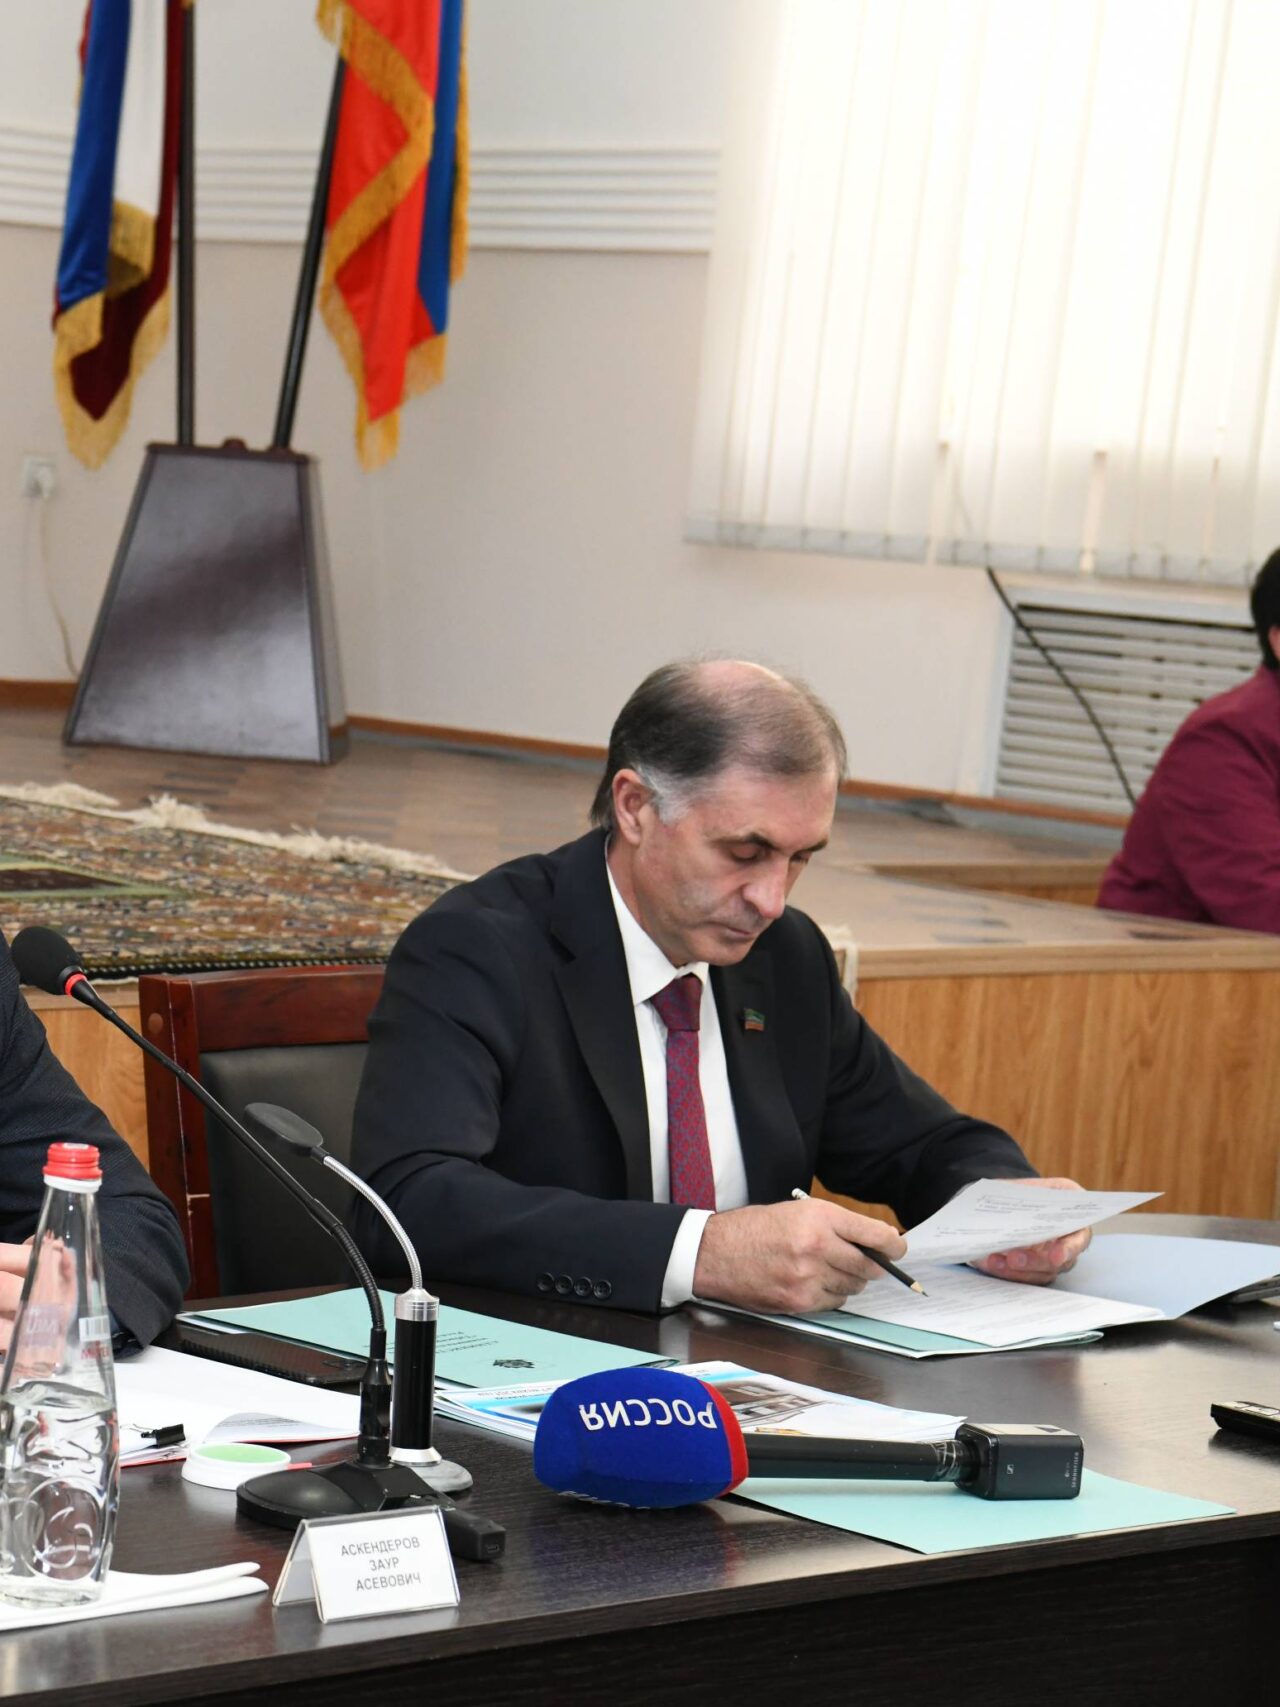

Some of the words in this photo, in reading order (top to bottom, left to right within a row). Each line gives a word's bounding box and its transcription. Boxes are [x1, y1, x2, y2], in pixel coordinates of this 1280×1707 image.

[579, 1398, 718, 1431] РОССИЯ
[341, 1536, 420, 1556] АСКЕНДЕРОВ
[369, 1556, 399, 1571] ЗАУР
[356, 1572, 421, 1591] АСЕВОВИЧ
